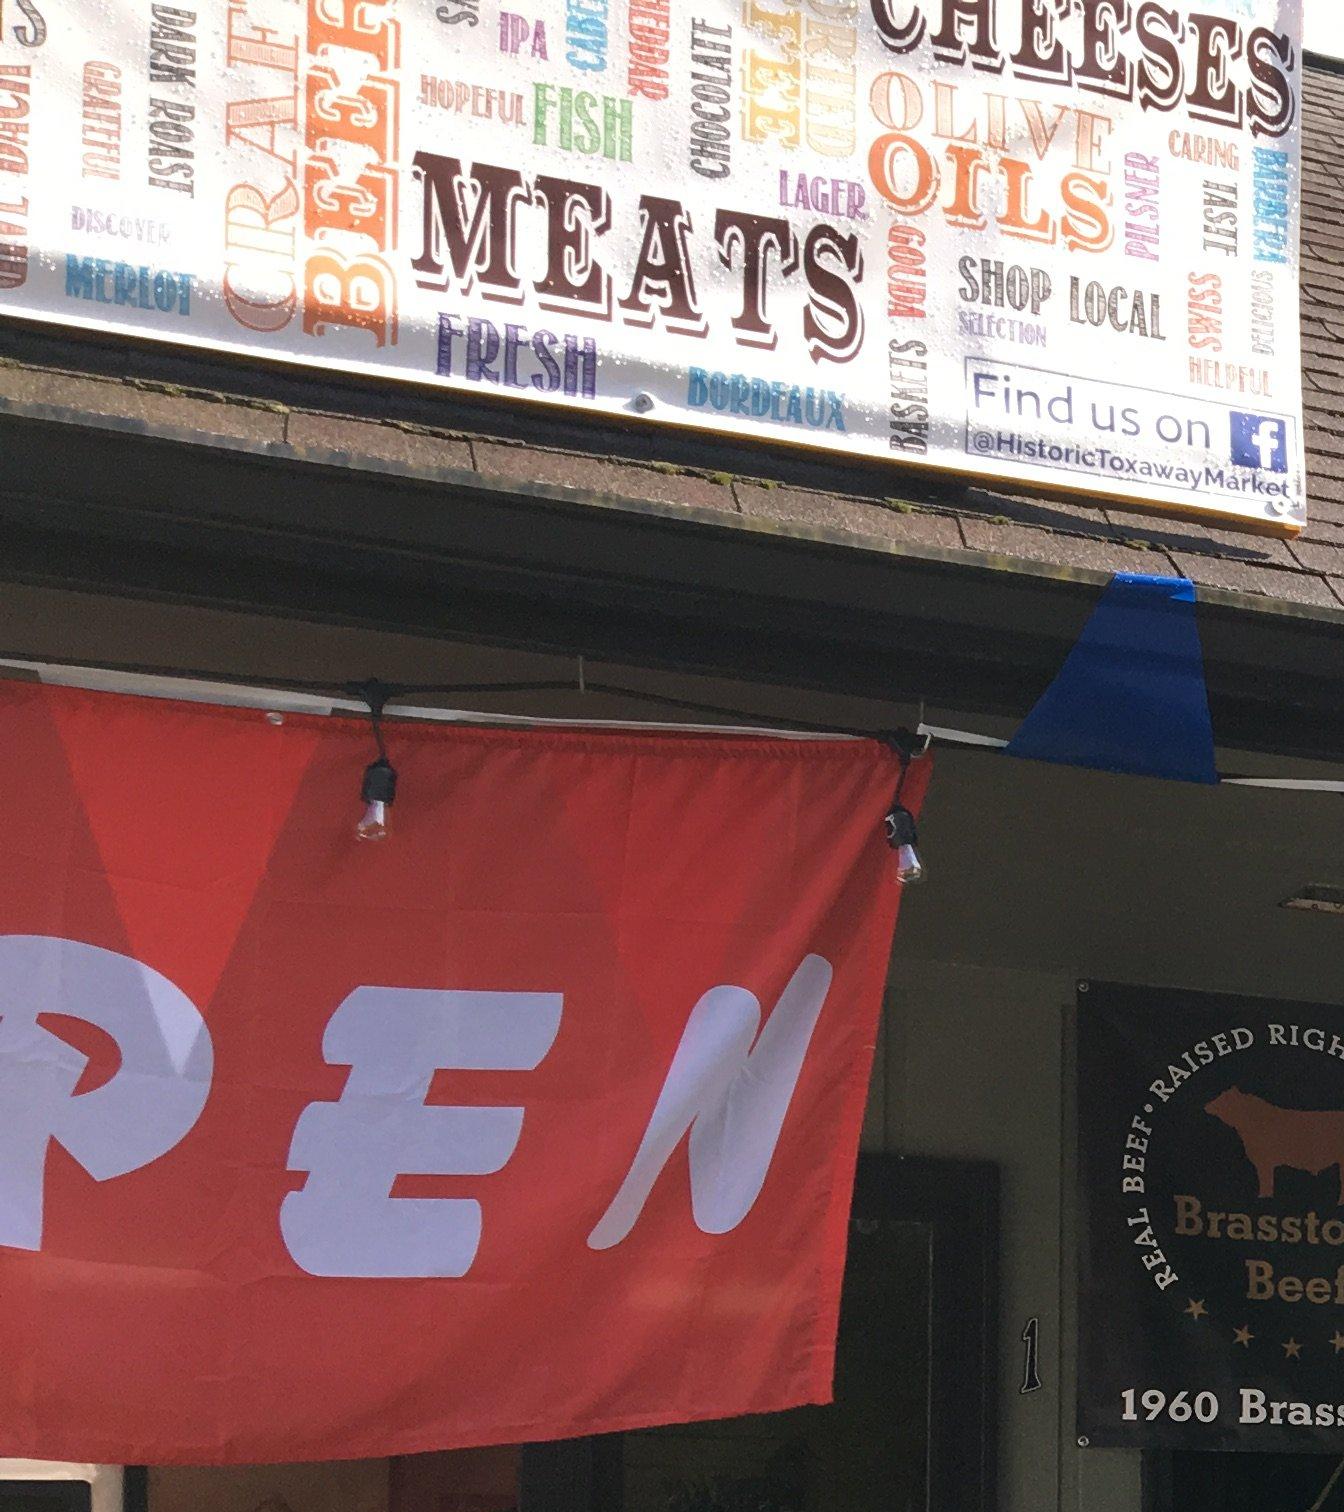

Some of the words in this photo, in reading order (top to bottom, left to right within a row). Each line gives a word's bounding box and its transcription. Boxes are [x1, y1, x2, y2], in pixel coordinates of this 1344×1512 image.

[150, 3, 197, 89] DARK
[500, 11, 549, 61] IPA
[82, 60, 122, 181] GRATEFUL
[416, 74, 527, 126] HOPEFUL
[532, 82, 634, 163] FISH
[690, 17, 732, 179] CHOCOLATE
[869, 71, 1114, 176] OLIVE
[148, 97, 196, 200] ROAST
[223, 0, 299, 333] CRAF
[1168, 129, 1240, 172] CARING
[70, 205, 173, 247] DISCOVER
[779, 169, 869, 220] LAGER
[867, 132, 1116, 253] OILS
[1124, 151, 1160, 262] PILSNER
[1203, 179, 1238, 257] TASTE
[65, 253, 191, 316] MERLOT
[411, 150, 866, 364] MEATS
[887, 225, 927, 318] GOUDA
[958, 255, 1052, 315] SHOP
[1070, 275, 1166, 341] LOCAL
[958, 310, 1047, 348] SELECTION
[1187, 271, 1222, 352] SWISS
[1251, 270, 1275, 356] DELICIOUS
[435, 312, 597, 399] FRESH
[1189, 356, 1274, 398] HELPFUL
[687, 366, 847, 432] BORDEAUX
[889, 338, 929, 456] BASKETS
[973, 372, 1074, 425] Find
[1091, 404, 1141, 437] us
[1156, 414, 1211, 449] on
[973, 430, 1290, 499] @HistoricToxawayMarket
[1150, 1026, 1254, 1102] RAISED
[1122, 1114, 1154, 1194] BEEF
[1127, 1208, 1178, 1290] REAL
[1021, 1318, 1041, 1394] 1
[1121, 1388, 1219, 1423] 1960
